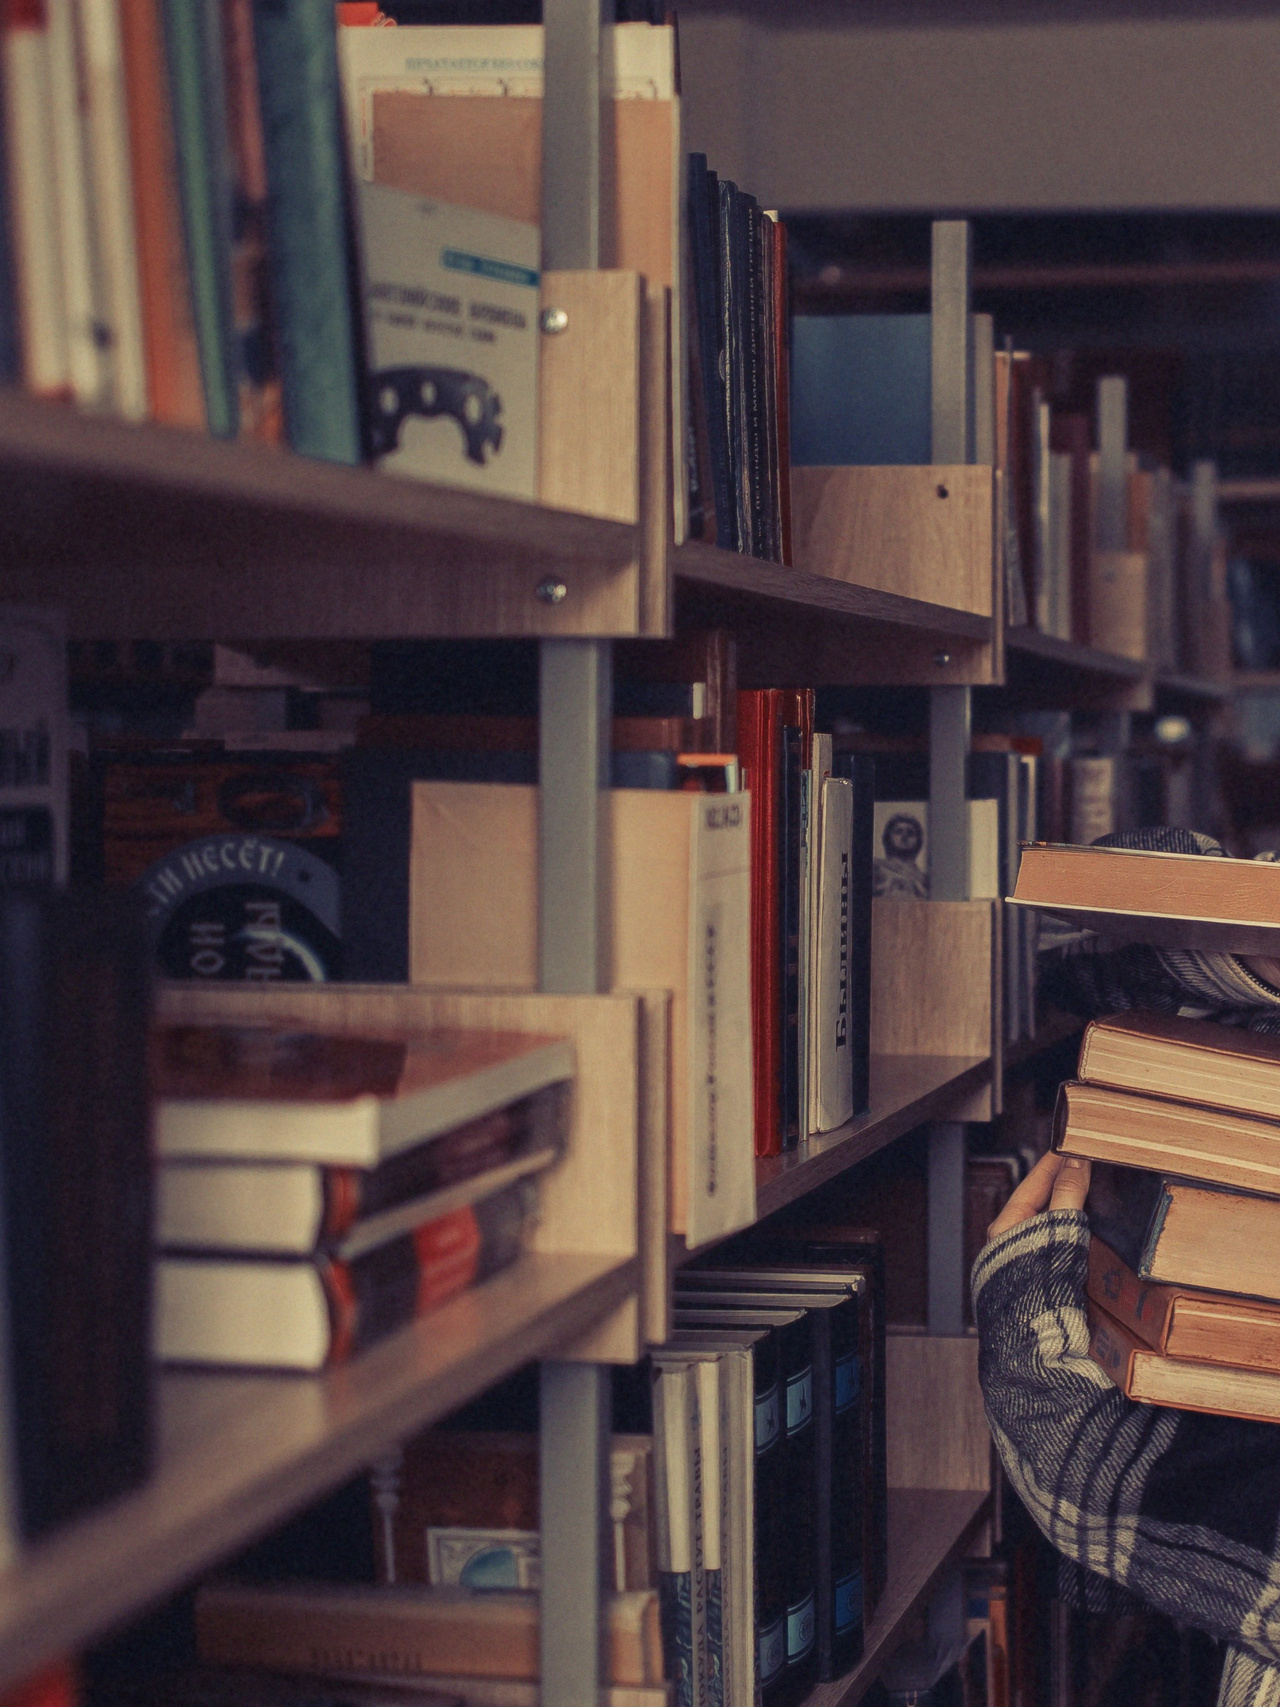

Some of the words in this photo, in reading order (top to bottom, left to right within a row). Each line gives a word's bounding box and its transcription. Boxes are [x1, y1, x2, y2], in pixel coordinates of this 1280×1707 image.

[180, 837, 286, 882] НЕСЁТ!
[835, 850, 849, 1050] Былины
[693, 1446, 702, 1522] ТРАВЫ
[695, 1534, 704, 1615] РАСТУТ
